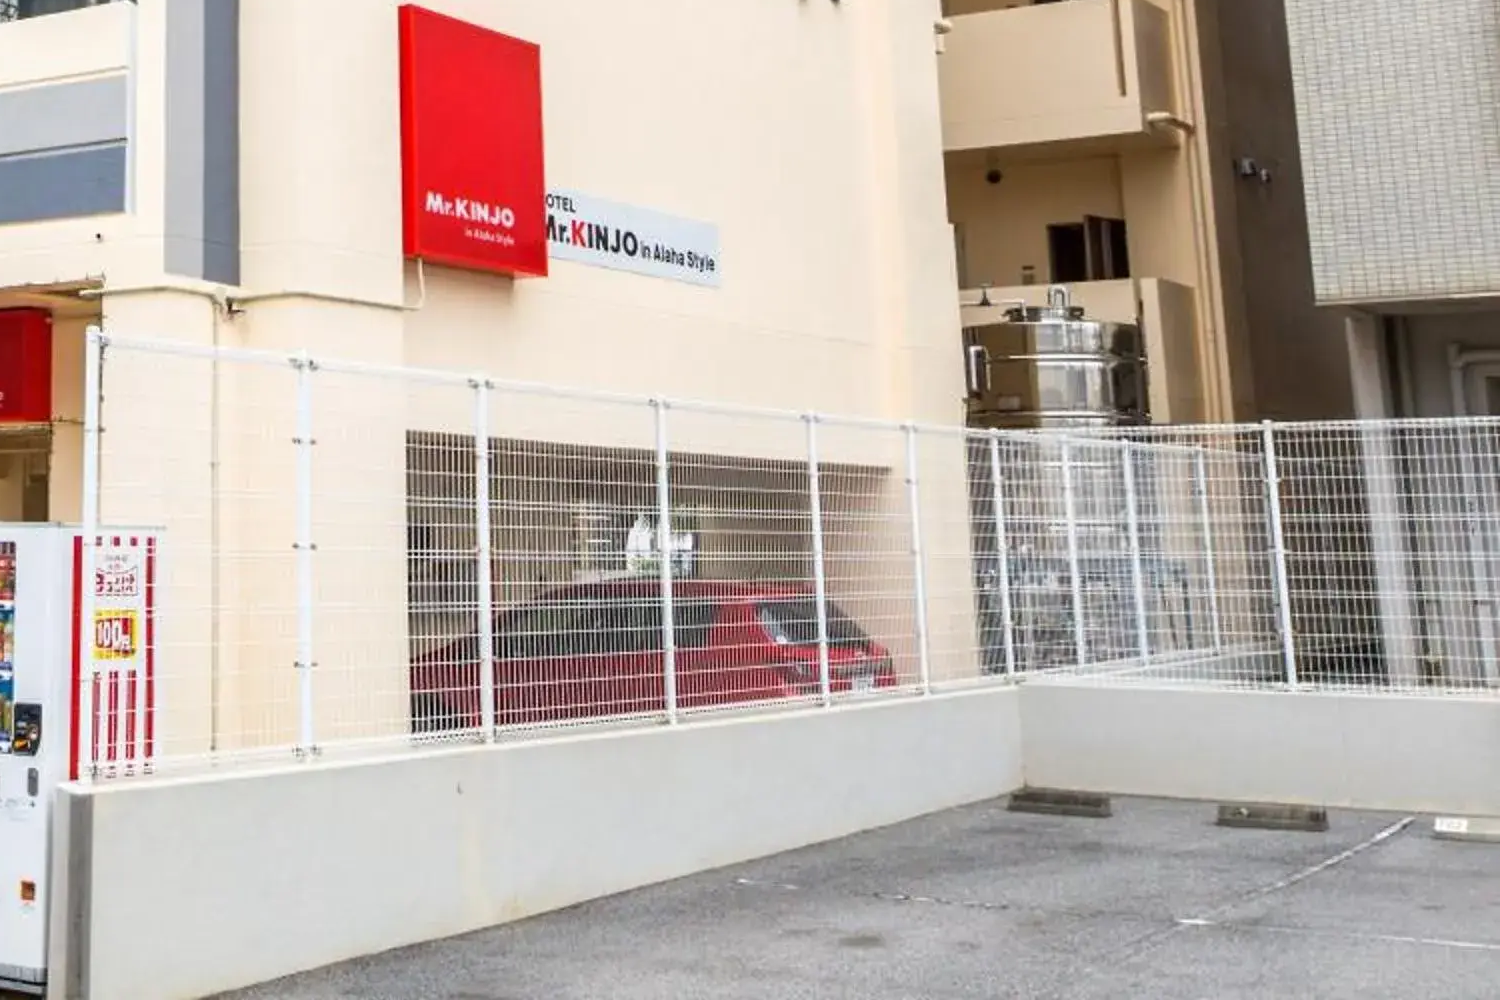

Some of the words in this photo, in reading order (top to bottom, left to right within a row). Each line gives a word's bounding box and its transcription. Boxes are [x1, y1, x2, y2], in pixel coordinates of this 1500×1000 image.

[425, 190, 515, 228] Mr.KINJO
[545, 193, 576, 213] OTEL
[640, 240, 651, 259] in
[687, 250, 715, 273] Style
